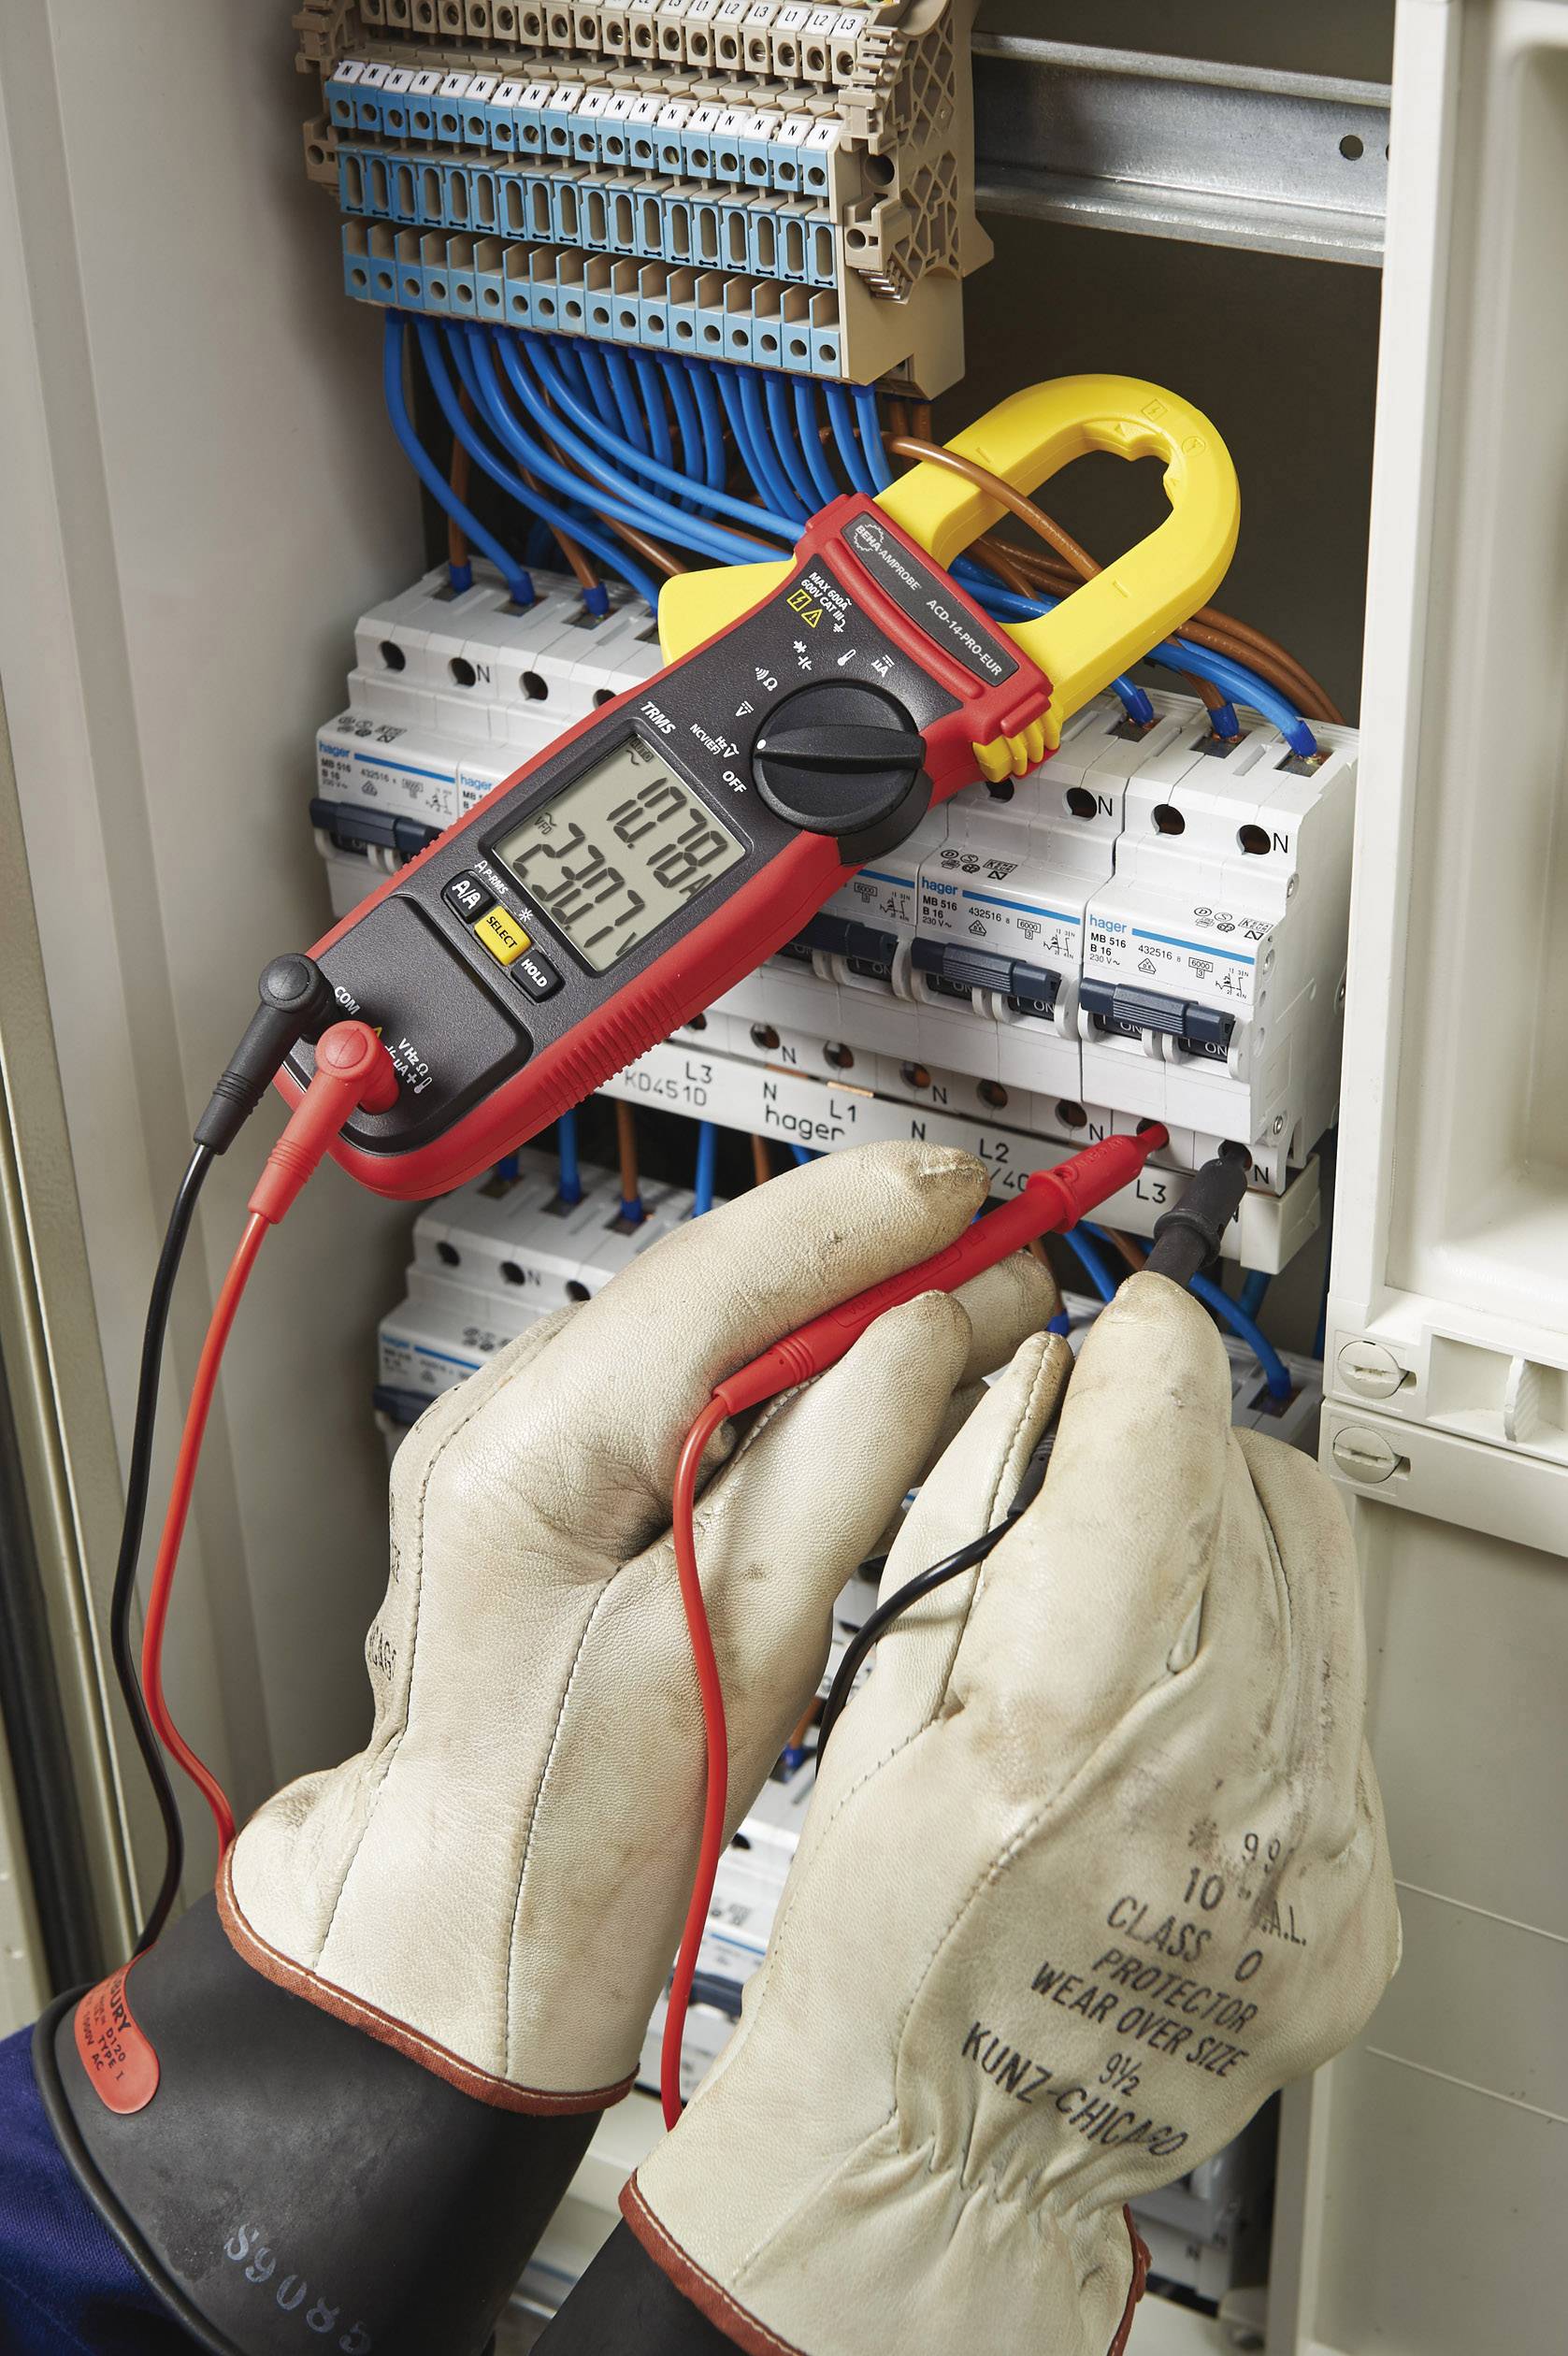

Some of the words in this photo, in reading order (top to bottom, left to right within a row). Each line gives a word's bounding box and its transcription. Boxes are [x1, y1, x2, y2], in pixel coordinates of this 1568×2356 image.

[725, 4, 740, 15] L2
[754, 7, 769, 18] L3
[784, 11, 798, 22] L1
[813, 14, 828, 26] L2
[840, 19, 856, 30] L3
[342, 65, 352, 76] N
[367, 68, 379, 79] N
[392, 74, 402, 84] N
[419, 76, 429, 86] N
[448, 79, 458, 89] N
[476, 81, 486, 92] N
[503, 87, 512, 97] N
[530, 90, 540, 100] N
[561, 92, 571, 102] N
[589, 97, 599, 108] N
[614, 100, 625, 110] N
[639, 103, 649, 113] N
[668, 109, 677, 120] N
[699, 111, 710, 122] N
[725, 115, 735, 126] N
[754, 121, 765, 131] N
[787, 126, 798, 137] N
[819, 129, 829, 140] N
[809, 572, 830, 593] MAX
[801, 580, 823, 602] 600V
[820, 596, 837, 613] CAT
[833, 610, 846, 622] III
[926, 599, 1002, 676] ACD-14-PRO-EUR
[477, 664, 491, 684] N
[640, 701, 676, 734] TRMS
[630, 738, 653, 762] AUTO
[689, 724, 723, 755] NCV(EF)
[715, 736, 728, 750] Hz
[460, 774, 492, 791] hager
[722, 770, 747, 793] OFF
[1098, 796, 1113, 816] N
[533, 816, 554, 836] VFD
[607, 777, 727, 888] 10.78
[679, 873, 712, 900] A
[1273, 832, 1288, 854] N
[513, 822, 645, 948] 230.7
[921, 876, 958, 896] hager
[922, 895, 938, 907] MB
[941, 899, 957, 912] 516
[922, 907, 930, 916] B
[933, 909, 943, 919] 16
[922, 916, 937, 926] 230
[969, 907, 1001, 922] 432516
[1089, 914, 1128, 934] hager
[486, 916, 518, 948] SELECT
[1019, 920, 1039, 931] 6000
[1090, 932, 1106, 944] MB
[1110, 936, 1127, 949] 516
[1090, 943, 1098, 953] B
[1100, 945, 1112, 956] 16
[1089, 953, 1105, 964] 230
[1138, 944, 1172, 960] 432516
[521, 958, 548, 987] HOLD
[1191, 959, 1210, 970] 6000
[334, 985, 361, 1015] COM
[1034, 999, 1055, 1013] ON
[398, 1038, 410, 1050] V
[404, 1047, 420, 1066] Hz
[782, 1046, 797, 1064] N
[1204, 1042, 1228, 1056] ON
[685, 1061, 712, 1085] L3
[763, 1082, 777, 1101] N
[932, 1086, 948, 1105] N
[829, 1099, 856, 1123] L1
[765, 1105, 845, 1142] hager
[911, 1120, 926, 1141] N
[1089, 1125, 1103, 1142] N
[980, 1138, 1010, 1164] L2
[1254, 1164, 1270, 1185] N
[1136, 1179, 1167, 1205] L3
[1183, 1866, 1225, 1911] 10
[1107, 1896, 1213, 1962] CLASS
[1091, 1947, 1259, 2034] PROTECTOR
[1030, 1961, 1118, 2024] WEAR
[1116, 2006, 1192, 2058] OVER
[1186, 2035, 1251, 2079] SIZE
[97, 2034, 117, 2069] TYPE
[106, 2027, 126, 2062] D120
[92, 2053, 104, 2071] AC
[961, 2021, 1189, 2158] KUNZ-CHICAGO
